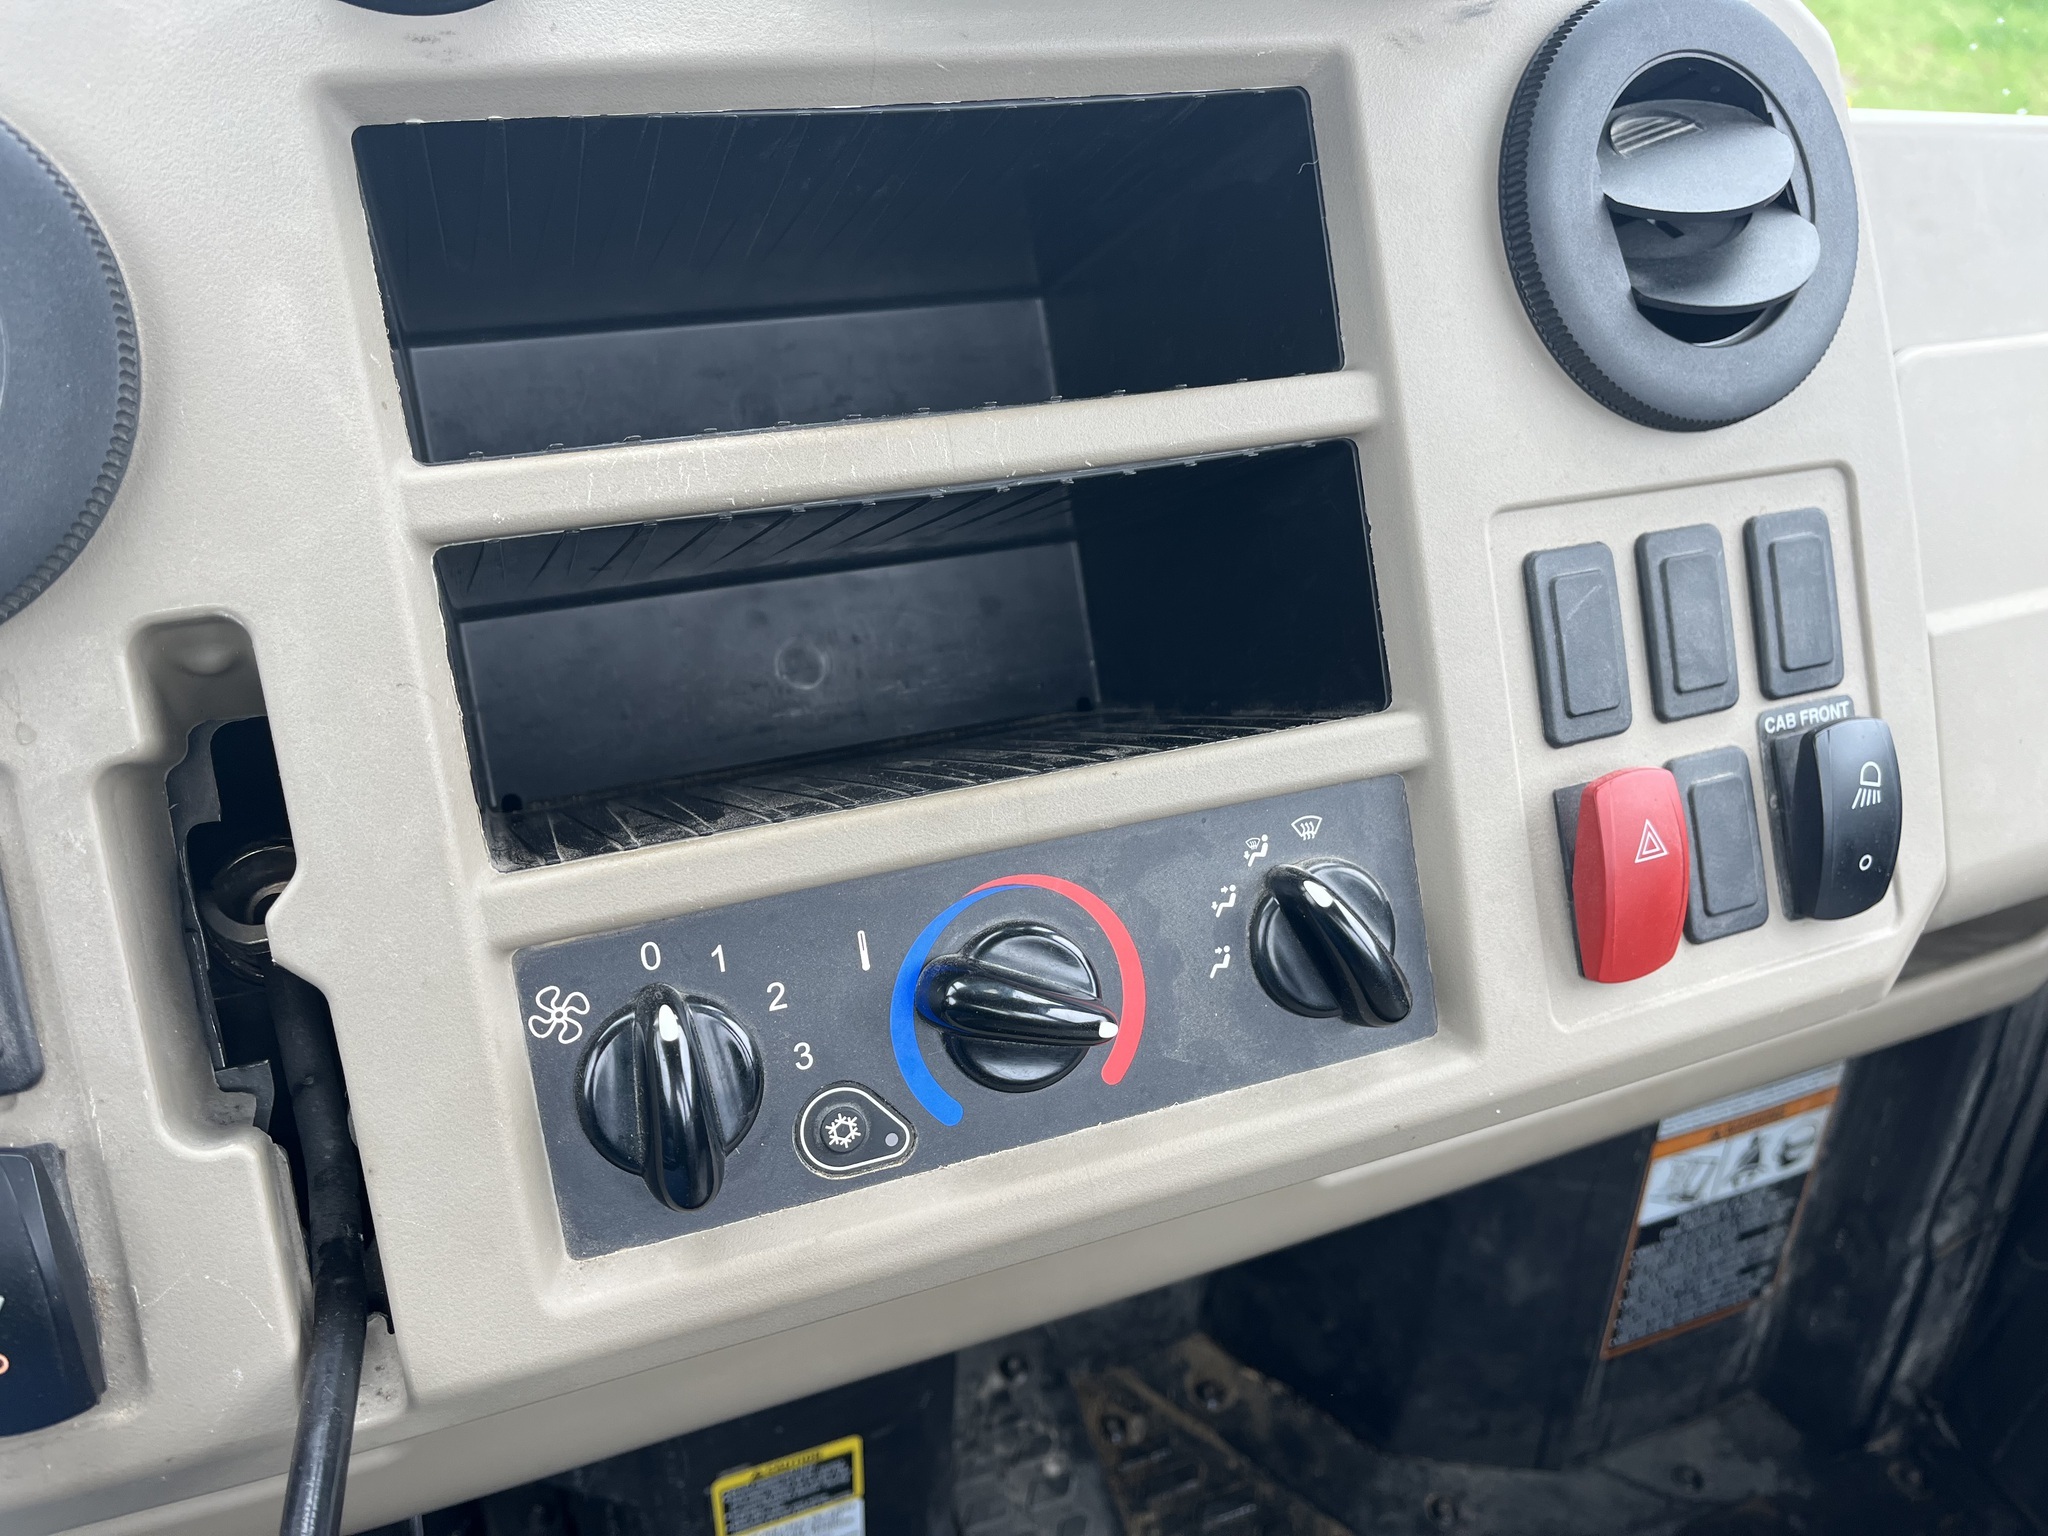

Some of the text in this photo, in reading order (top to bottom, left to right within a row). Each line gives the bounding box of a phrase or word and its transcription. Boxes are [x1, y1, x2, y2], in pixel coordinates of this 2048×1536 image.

[1764, 701, 1850, 734] CAB FRONT
[640, 941, 662, 971] 0
[710, 944, 726, 973] 1
[766, 981, 788, 1012] 2
[793, 1041, 814, 1070] 3
